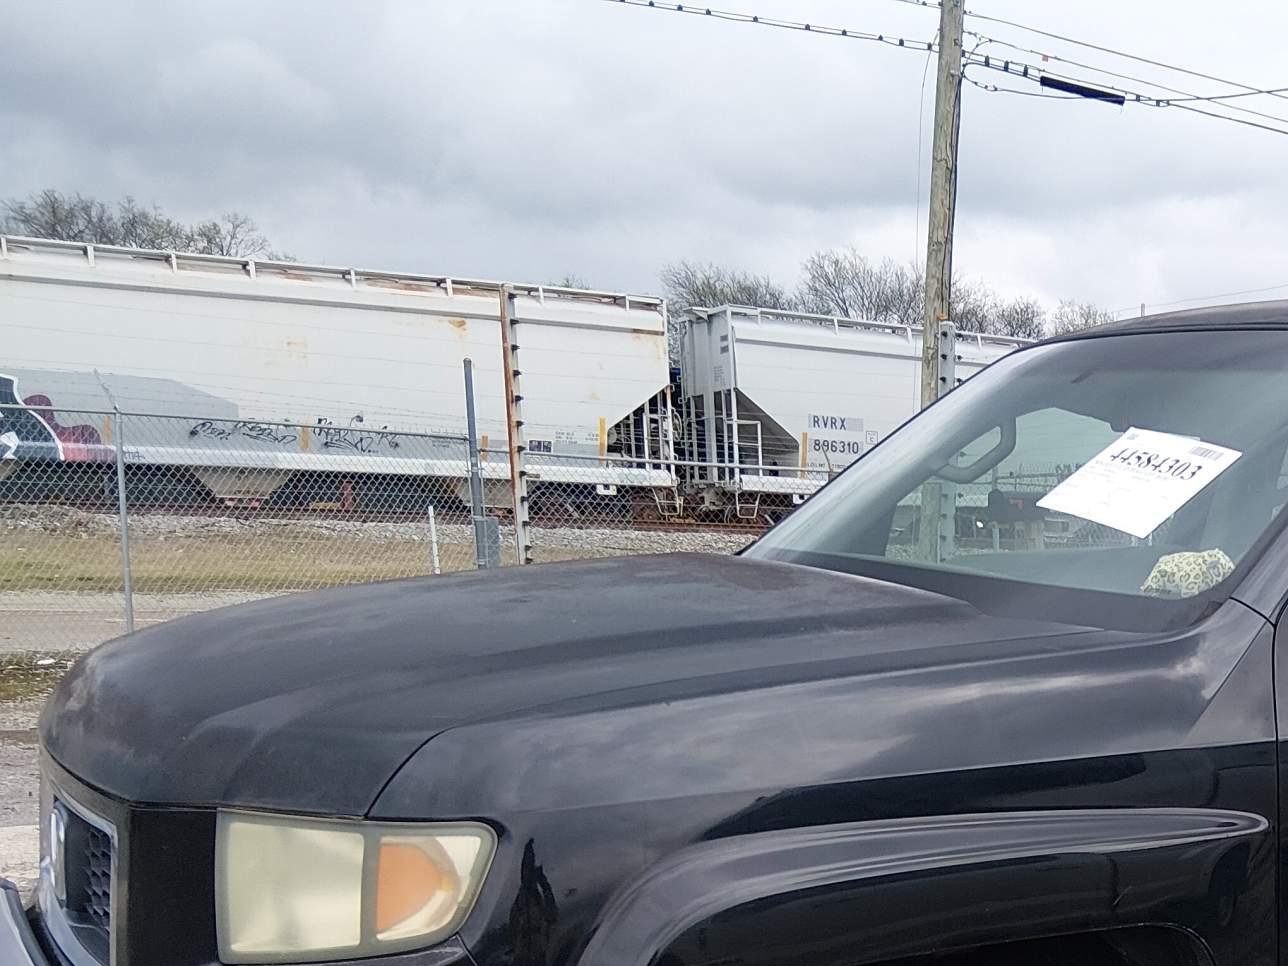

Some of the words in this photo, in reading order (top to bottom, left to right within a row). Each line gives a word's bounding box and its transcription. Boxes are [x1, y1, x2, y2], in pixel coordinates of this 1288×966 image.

[813, 415, 847, 431] RVRX
[813, 439, 859, 454] 896310
[1110, 447, 1203, 481] 44584303
